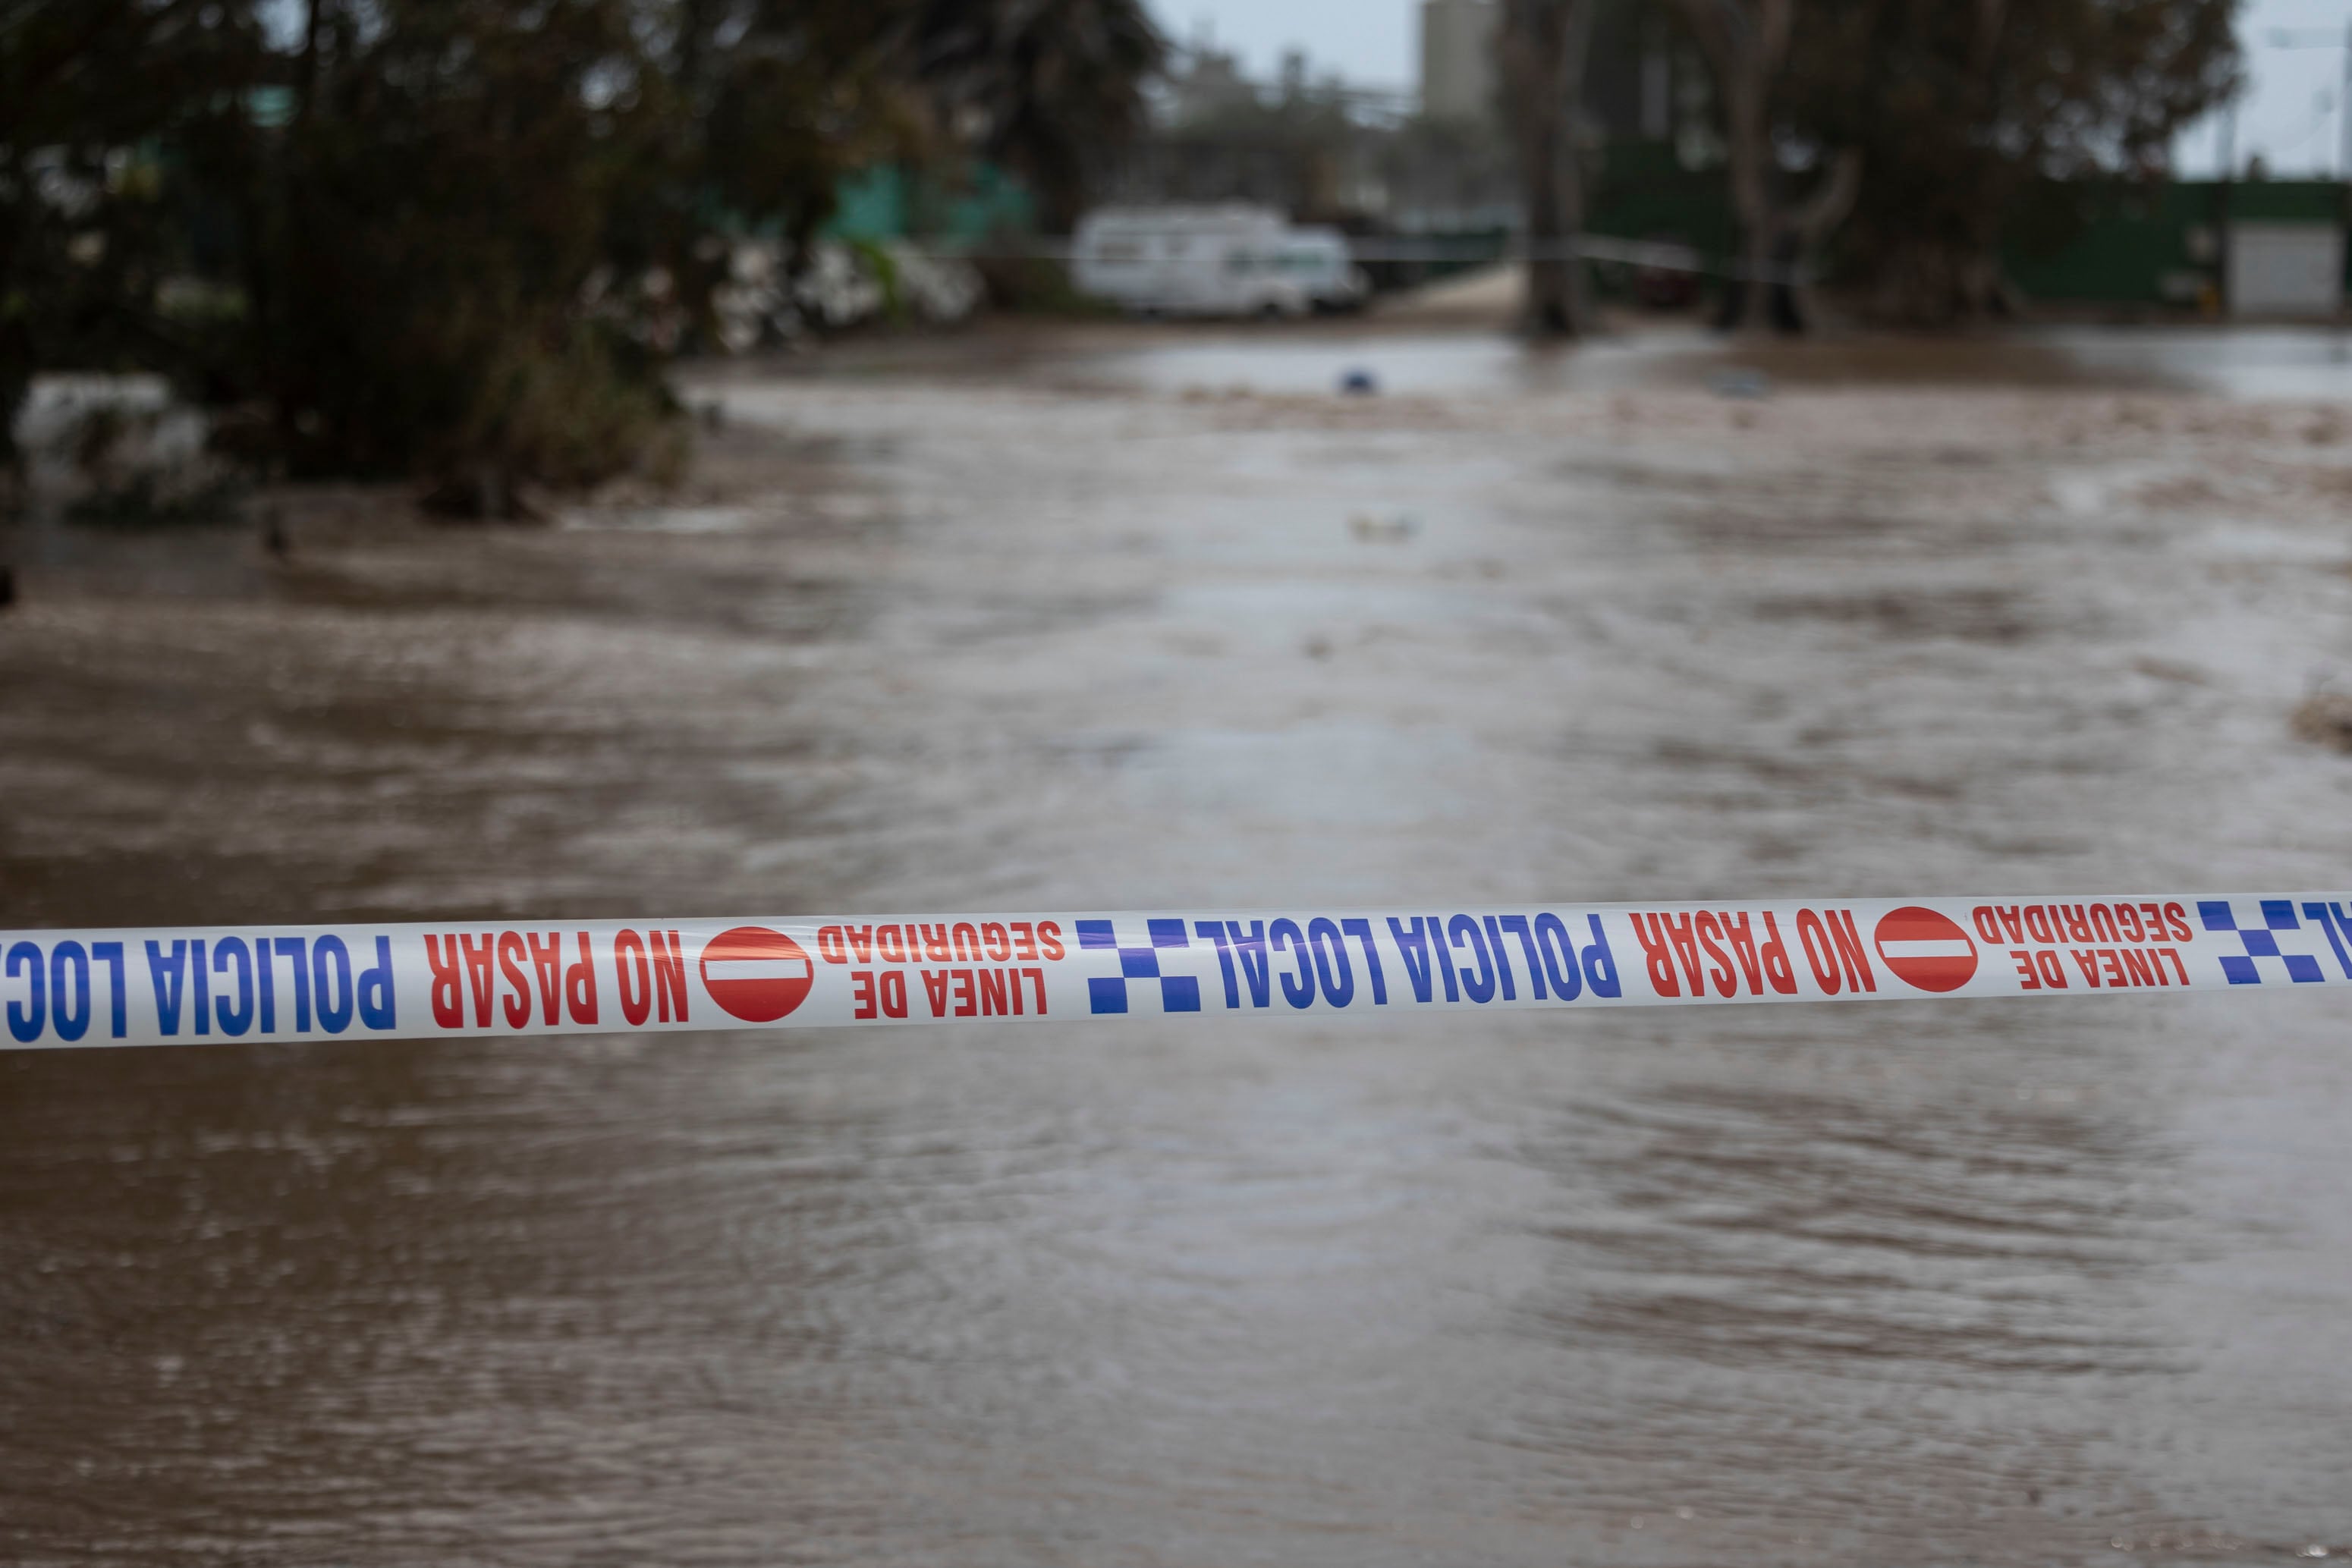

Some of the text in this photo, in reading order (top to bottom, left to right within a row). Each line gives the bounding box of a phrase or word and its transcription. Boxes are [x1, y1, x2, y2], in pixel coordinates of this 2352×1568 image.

[817, 920, 1065, 964] SEGURIDAD
[1628, 908, 1877, 998] NO PASAR
[1972, 902, 2193, 945] SEGURIDAD
[0, 934, 396, 1043] POLICIA LOC
[423, 929, 690, 1029] NO PASAR
[851, 968, 1048, 1020] LINEA DE
[1194, 913, 1623, 1010] POLICIA LOCAL
[2010, 948, 2190, 990] LINEA DE
